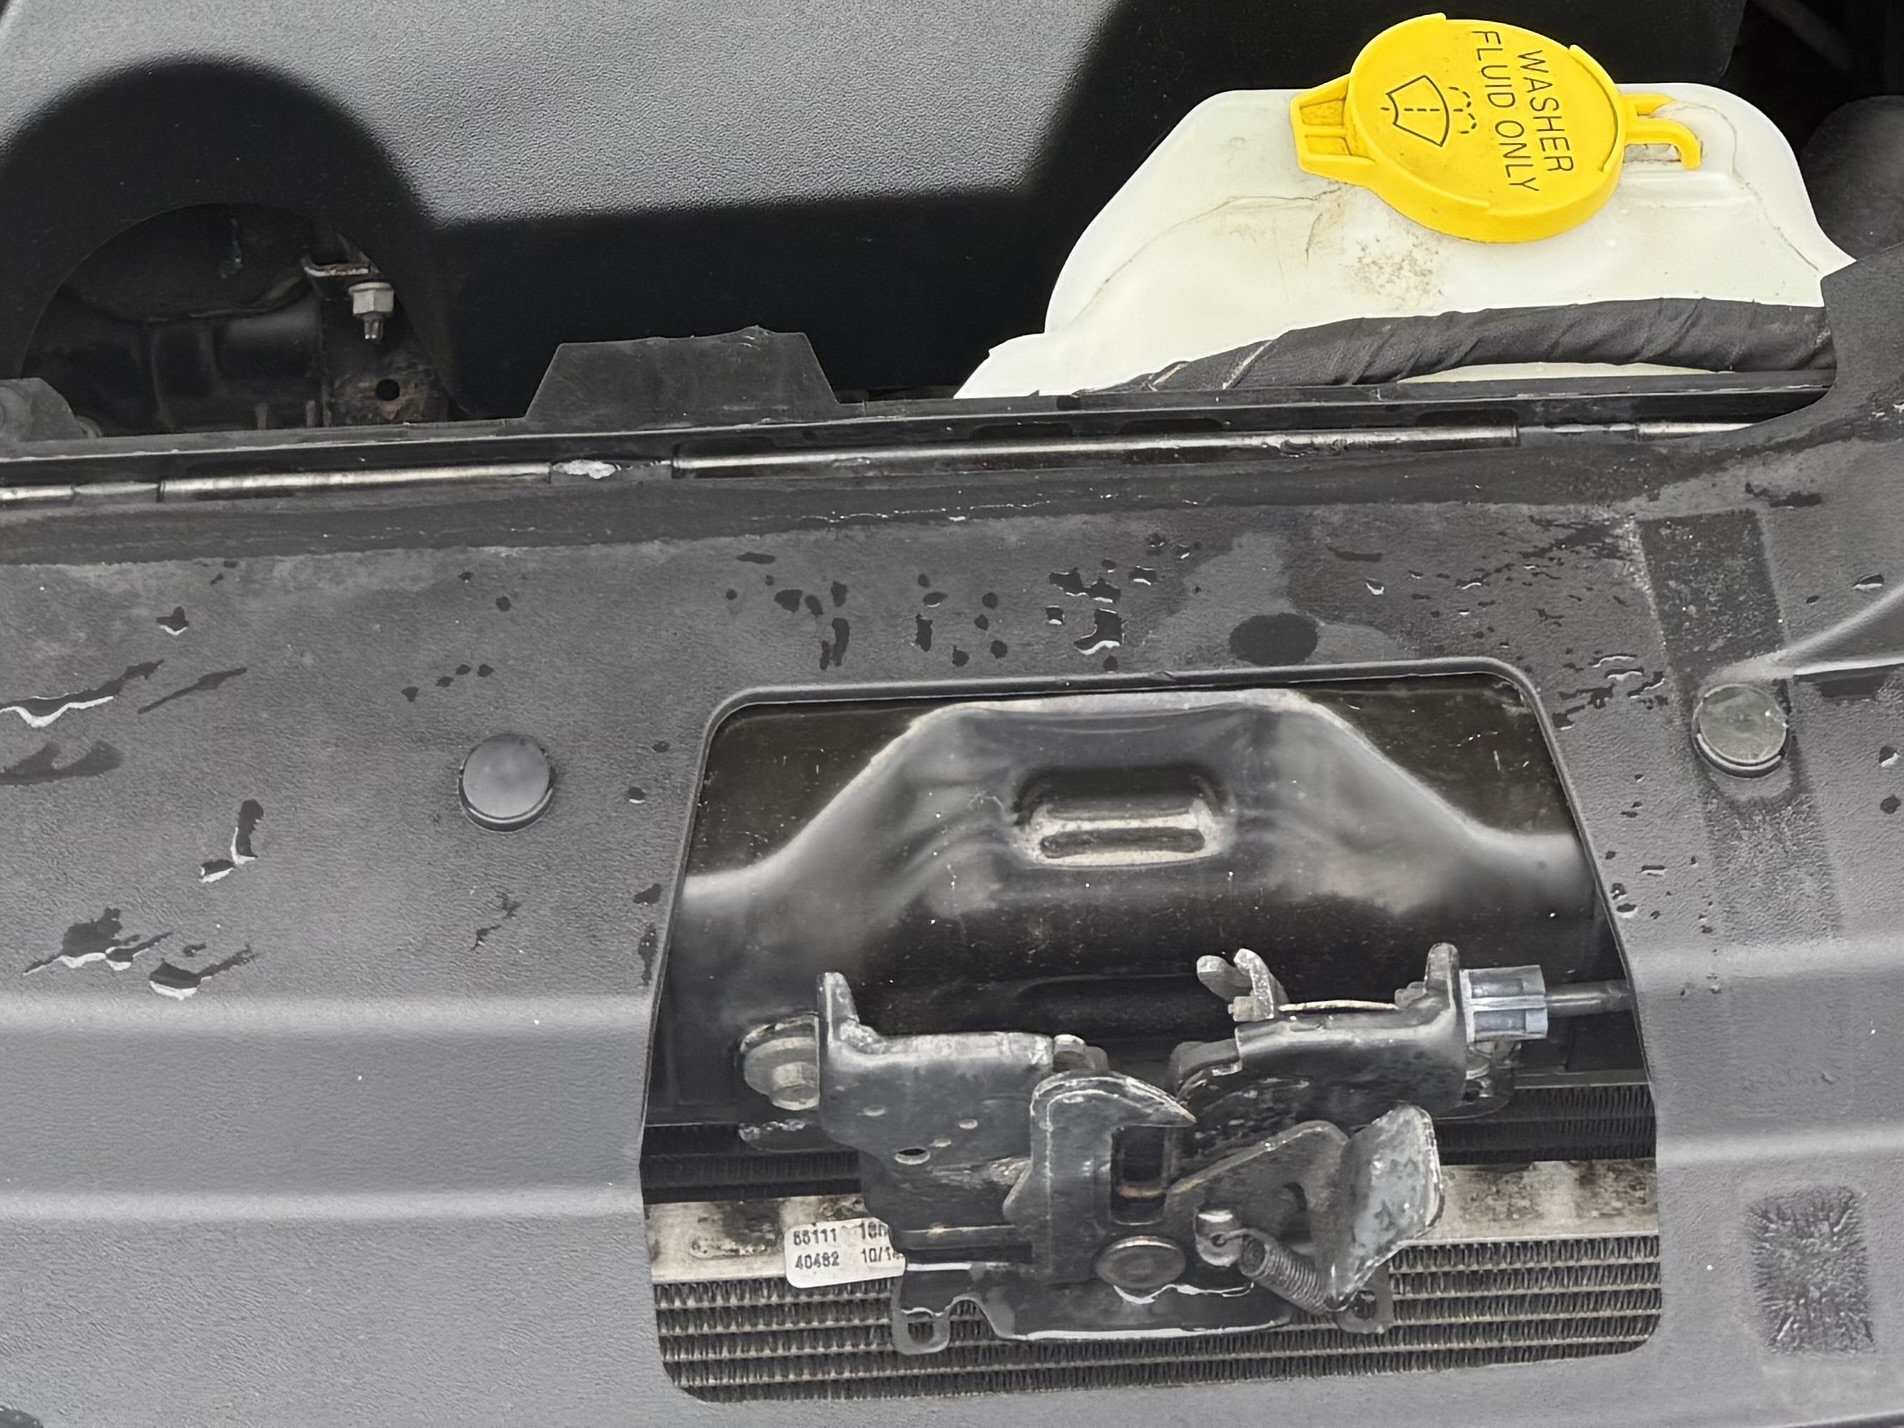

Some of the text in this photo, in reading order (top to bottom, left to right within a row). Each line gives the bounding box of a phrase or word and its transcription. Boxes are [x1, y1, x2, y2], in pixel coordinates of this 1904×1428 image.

[1471, 30, 1540, 192] FLUID ONLY
[1516, 49, 1574, 172] WASHER
